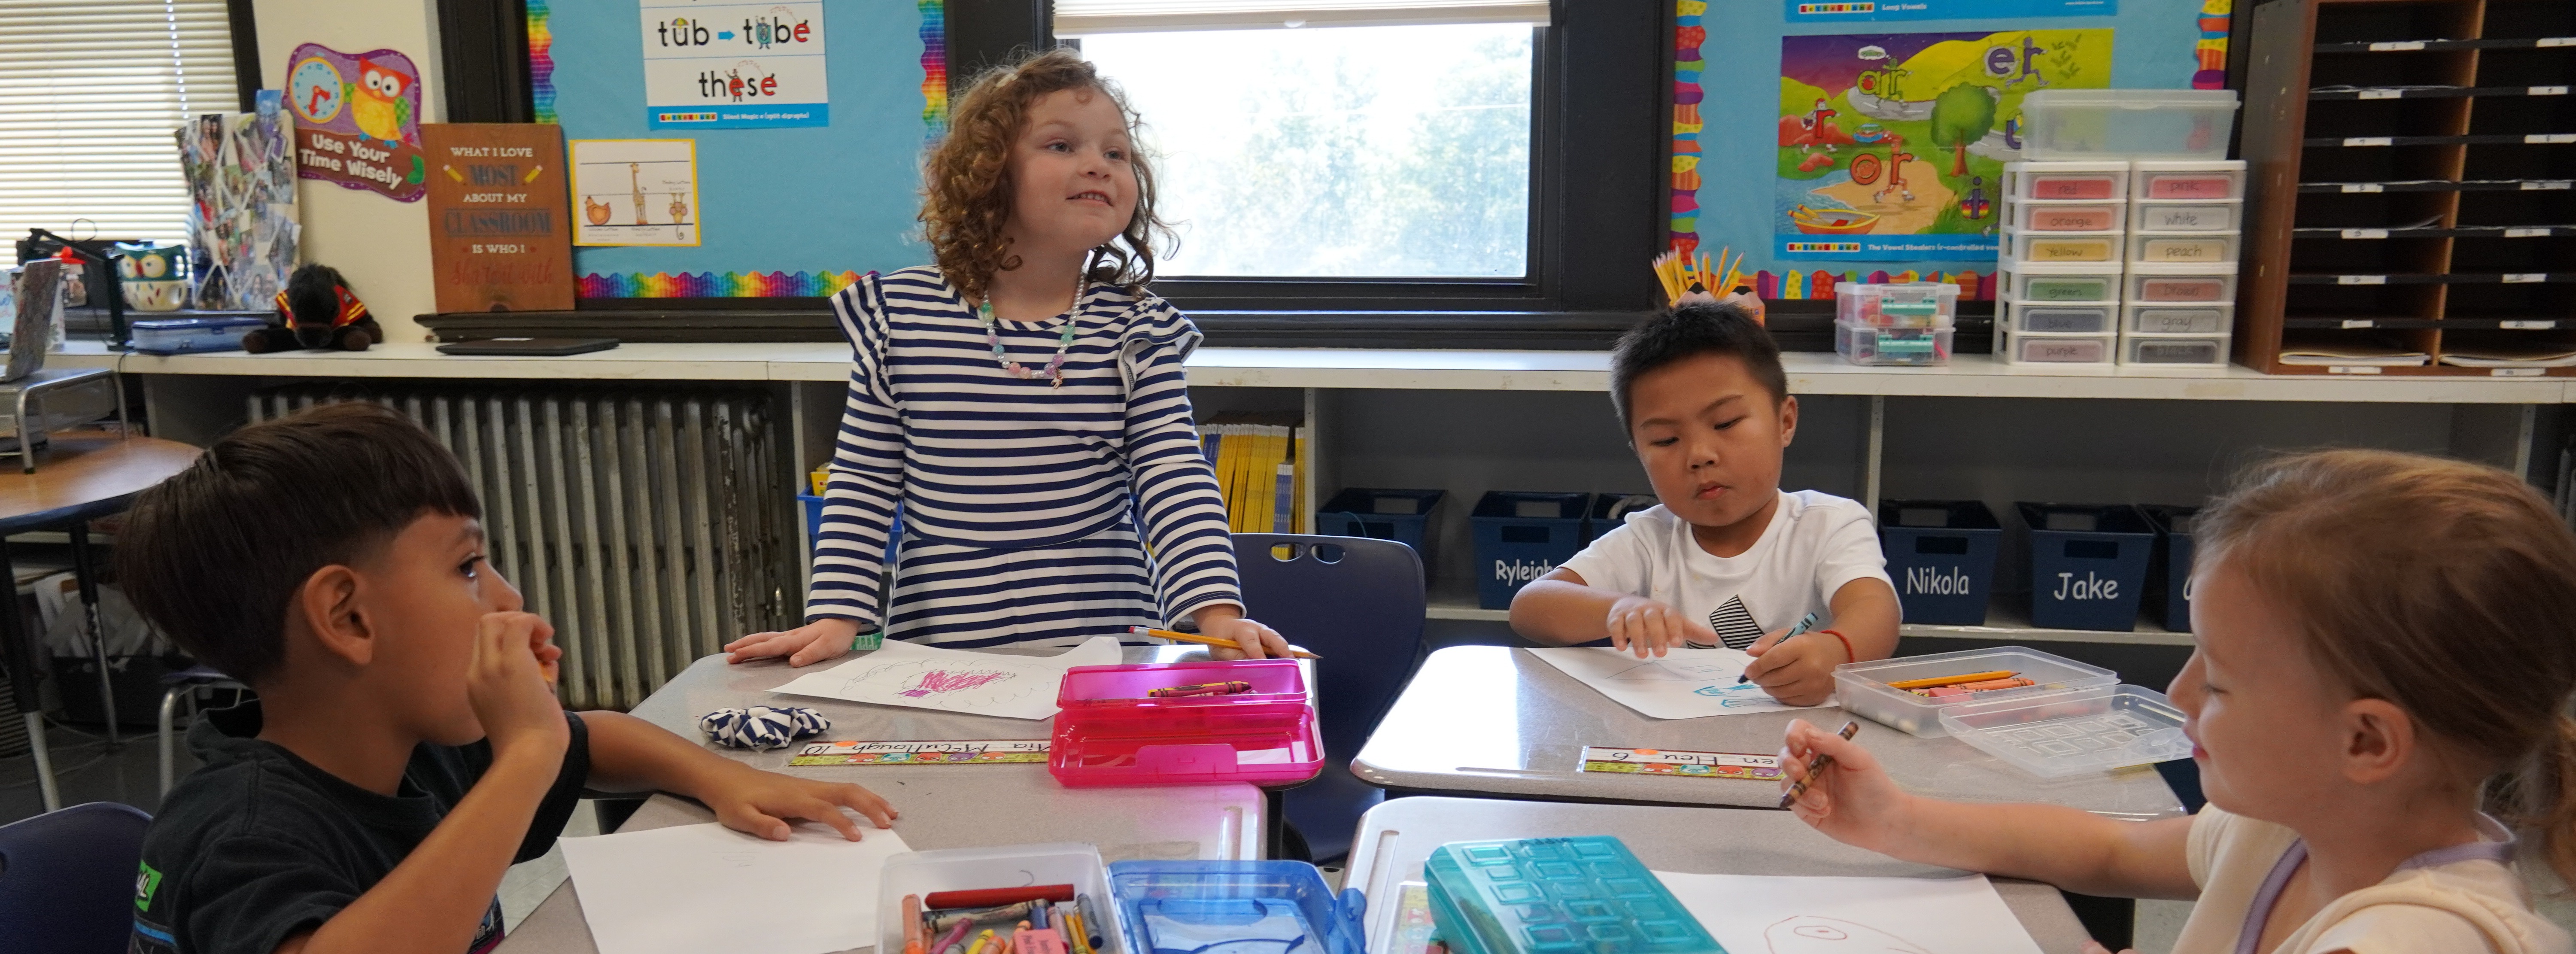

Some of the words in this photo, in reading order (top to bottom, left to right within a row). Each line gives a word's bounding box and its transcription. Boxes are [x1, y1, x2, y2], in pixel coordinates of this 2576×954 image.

[659, 19, 710, 46] tub
[743, 17, 810, 44] tube
[699, 71, 778, 97] these
[311, 133, 345, 155] Use
[348, 140, 390, 164] Your
[450, 147, 490, 157] WHAT
[492, 148, 498, 157] I
[499, 148, 533, 157] LOVE
[300, 149, 342, 172] Time
[346, 160, 403, 190] Wisely
[468, 164, 519, 186] MOST
[2058, 182, 2078, 194] red
[2170, 182, 2199, 192] pink
[463, 194, 504, 203] ABOUT
[507, 194, 527, 203] MY
[444, 212, 551, 233] CLASSROOM
[2050, 218, 2092, 227] orange
[2165, 213, 2197, 226] white
[472, 245, 483, 253] IS
[486, 244, 518, 253] WHO
[520, 245, 525, 253] I
[2166, 245, 2202, 258] peach
[2049, 288, 2082, 298] green
[2162, 316, 2195, 330] gray
[2046, 346, 2078, 357] purple
[1907, 566, 1969, 595] Nikola
[2054, 571, 2119, 601] Jake
[805, 745, 831, 755] 10
[853, 742, 989, 753] McCullough
[1613, 752, 1629, 761] 6
